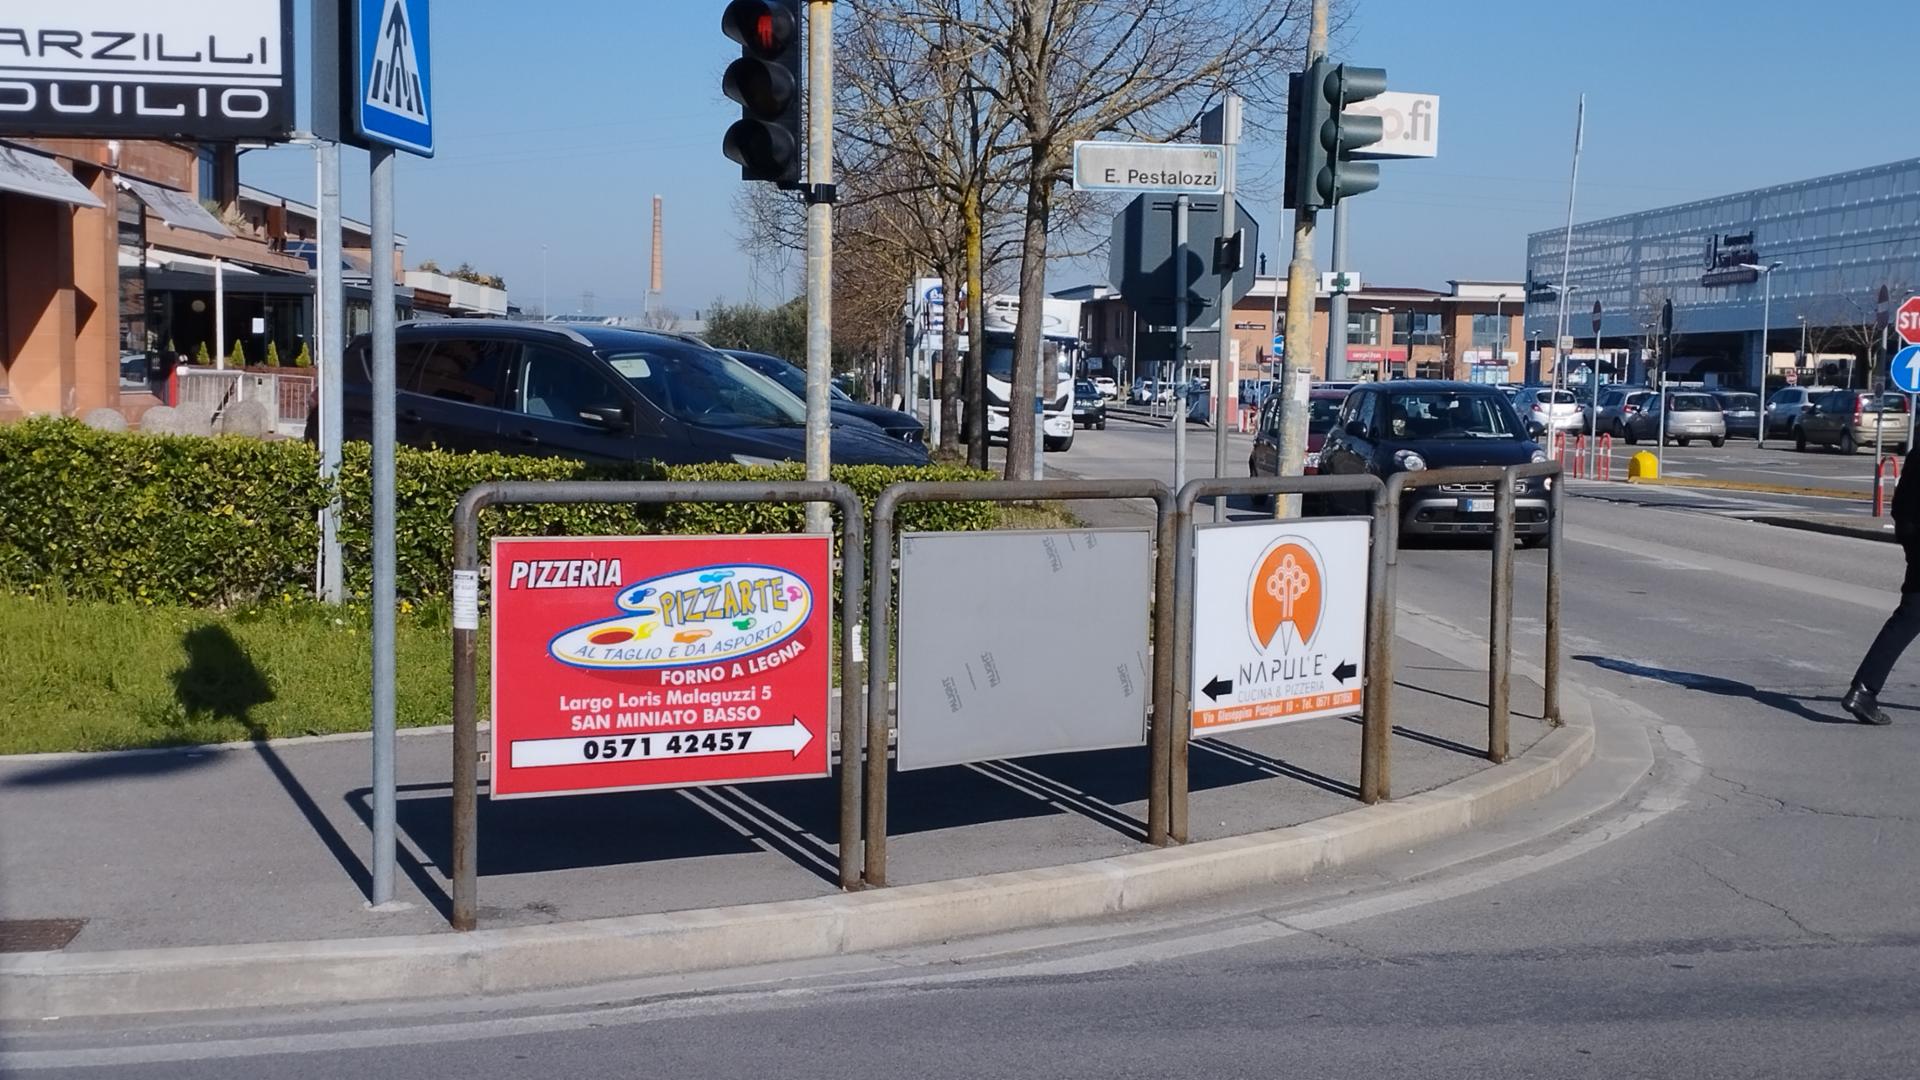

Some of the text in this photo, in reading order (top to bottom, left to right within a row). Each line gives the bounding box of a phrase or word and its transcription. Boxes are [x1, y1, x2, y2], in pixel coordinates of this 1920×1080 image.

[1105, 168, 1217, 186] E. Pestalozzi
[1899, 311, 1920, 330] ST
[509, 559, 622, 590] PIZZERIA
[574, 620, 783, 660] AL TAGLIO E DA ASPORTO
[661, 639, 806, 686] FORNO A LEGNA
[559, 685, 772, 714] Largo Loris Malaguzzi 5
[1238, 686, 1273, 703] CUCINA
[1285, 680, 1325, 697] PIZZERIA
[571, 705, 761, 731] SAN MINIATO BASSO
[583, 731, 752, 760] 0571 42457
